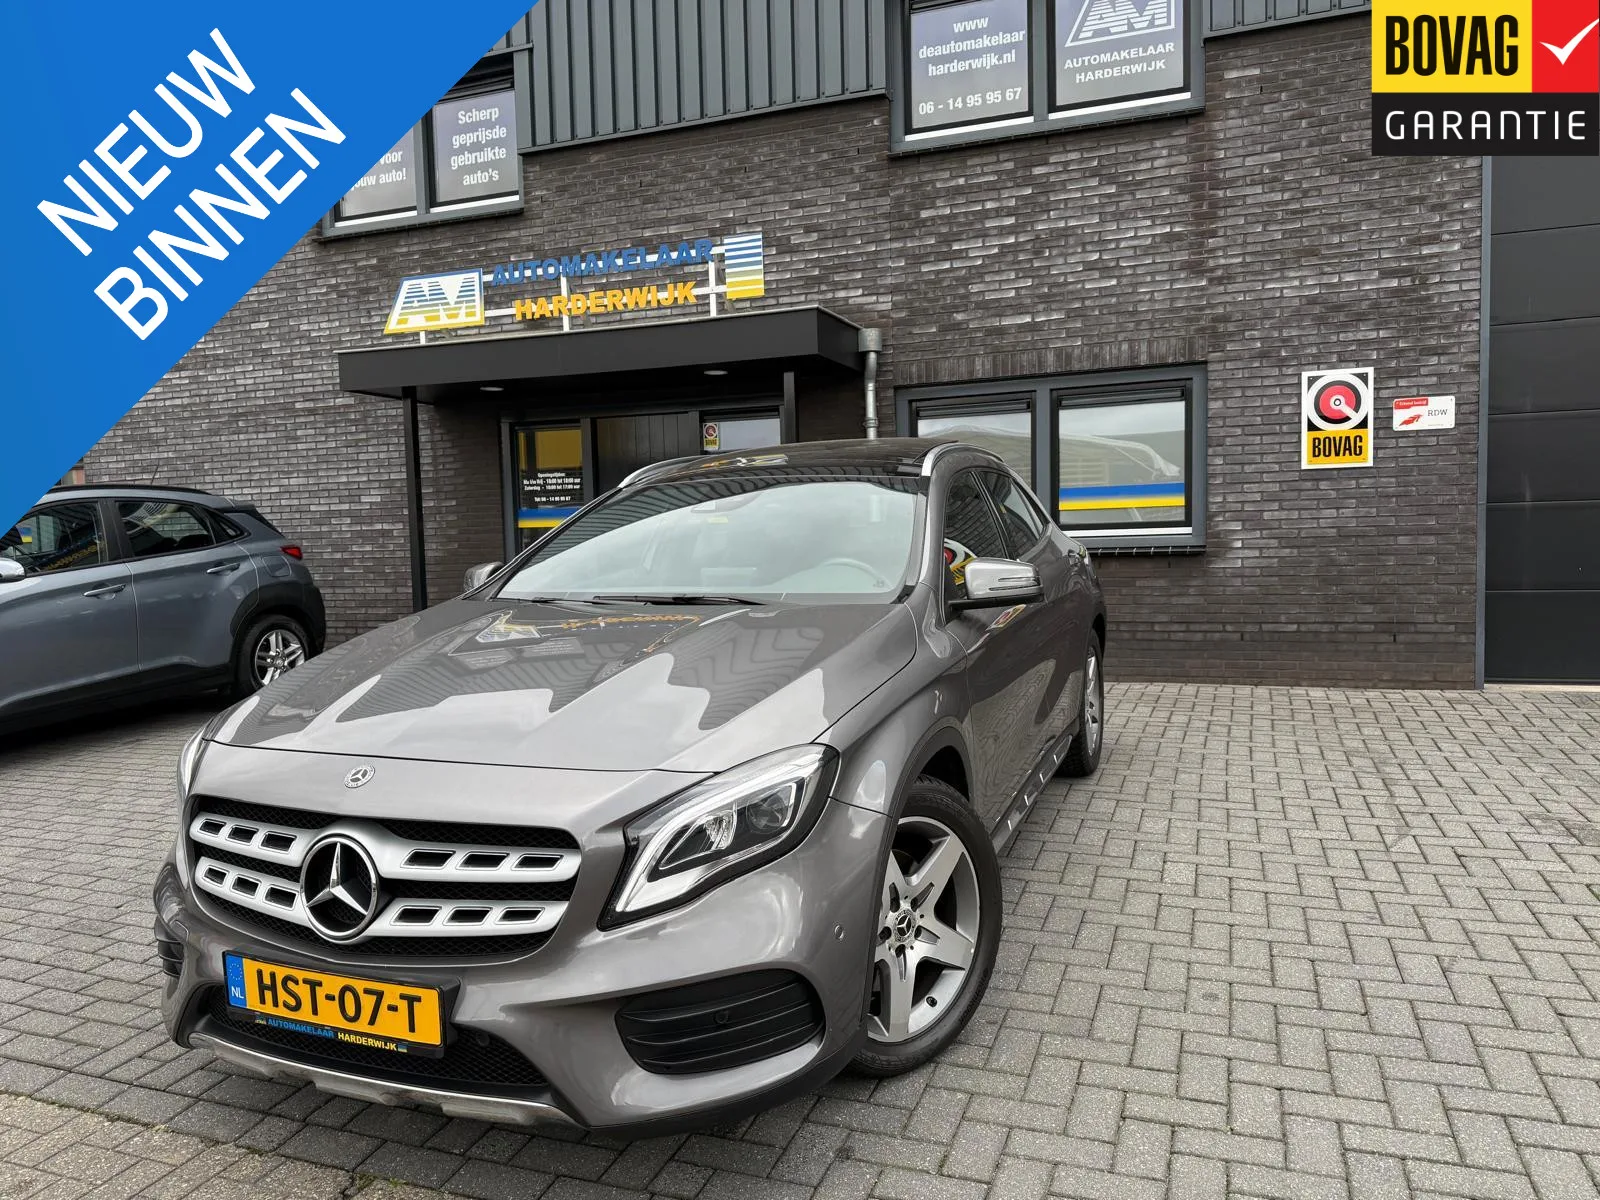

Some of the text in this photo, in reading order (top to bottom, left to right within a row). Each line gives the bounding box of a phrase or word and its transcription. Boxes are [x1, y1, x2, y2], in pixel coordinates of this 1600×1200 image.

[953, 17, 989, 33] www
[919, 29, 1026, 59] deautomakelaar
[1064, 42, 1175, 69] AUTOMAKELAAR
[928, 49, 1016, 76] harderwijk.nl
[1075, 59, 1166, 83] HARDERWIJK
[918, 101, 935, 115] 06
[947, 96, 963, 110] 14
[966, 93, 982, 107] 95
[986, 90, 1002, 104] 95
[1005, 87, 1022, 101] 67
[457, 107, 499, 124] Scherp
[452, 125, 507, 149] geprijsde
[450, 146, 507, 170] gebruikte
[351, 168, 406, 191] ouw auto!
[462, 169, 499, 186] auto's
[491, 239, 713, 287] AUTOMAKELAAR
[515, 281, 697, 321] HARDERWIJK
[1312, 435, 1363, 458] BOVAG
[231, 986, 245, 999] NL
[256, 968, 422, 1033] HST-07-T
[268, 1016, 335, 1039] AUTOMAKELAAR
[337, 1032, 397, 1051] HARDERWIJK
